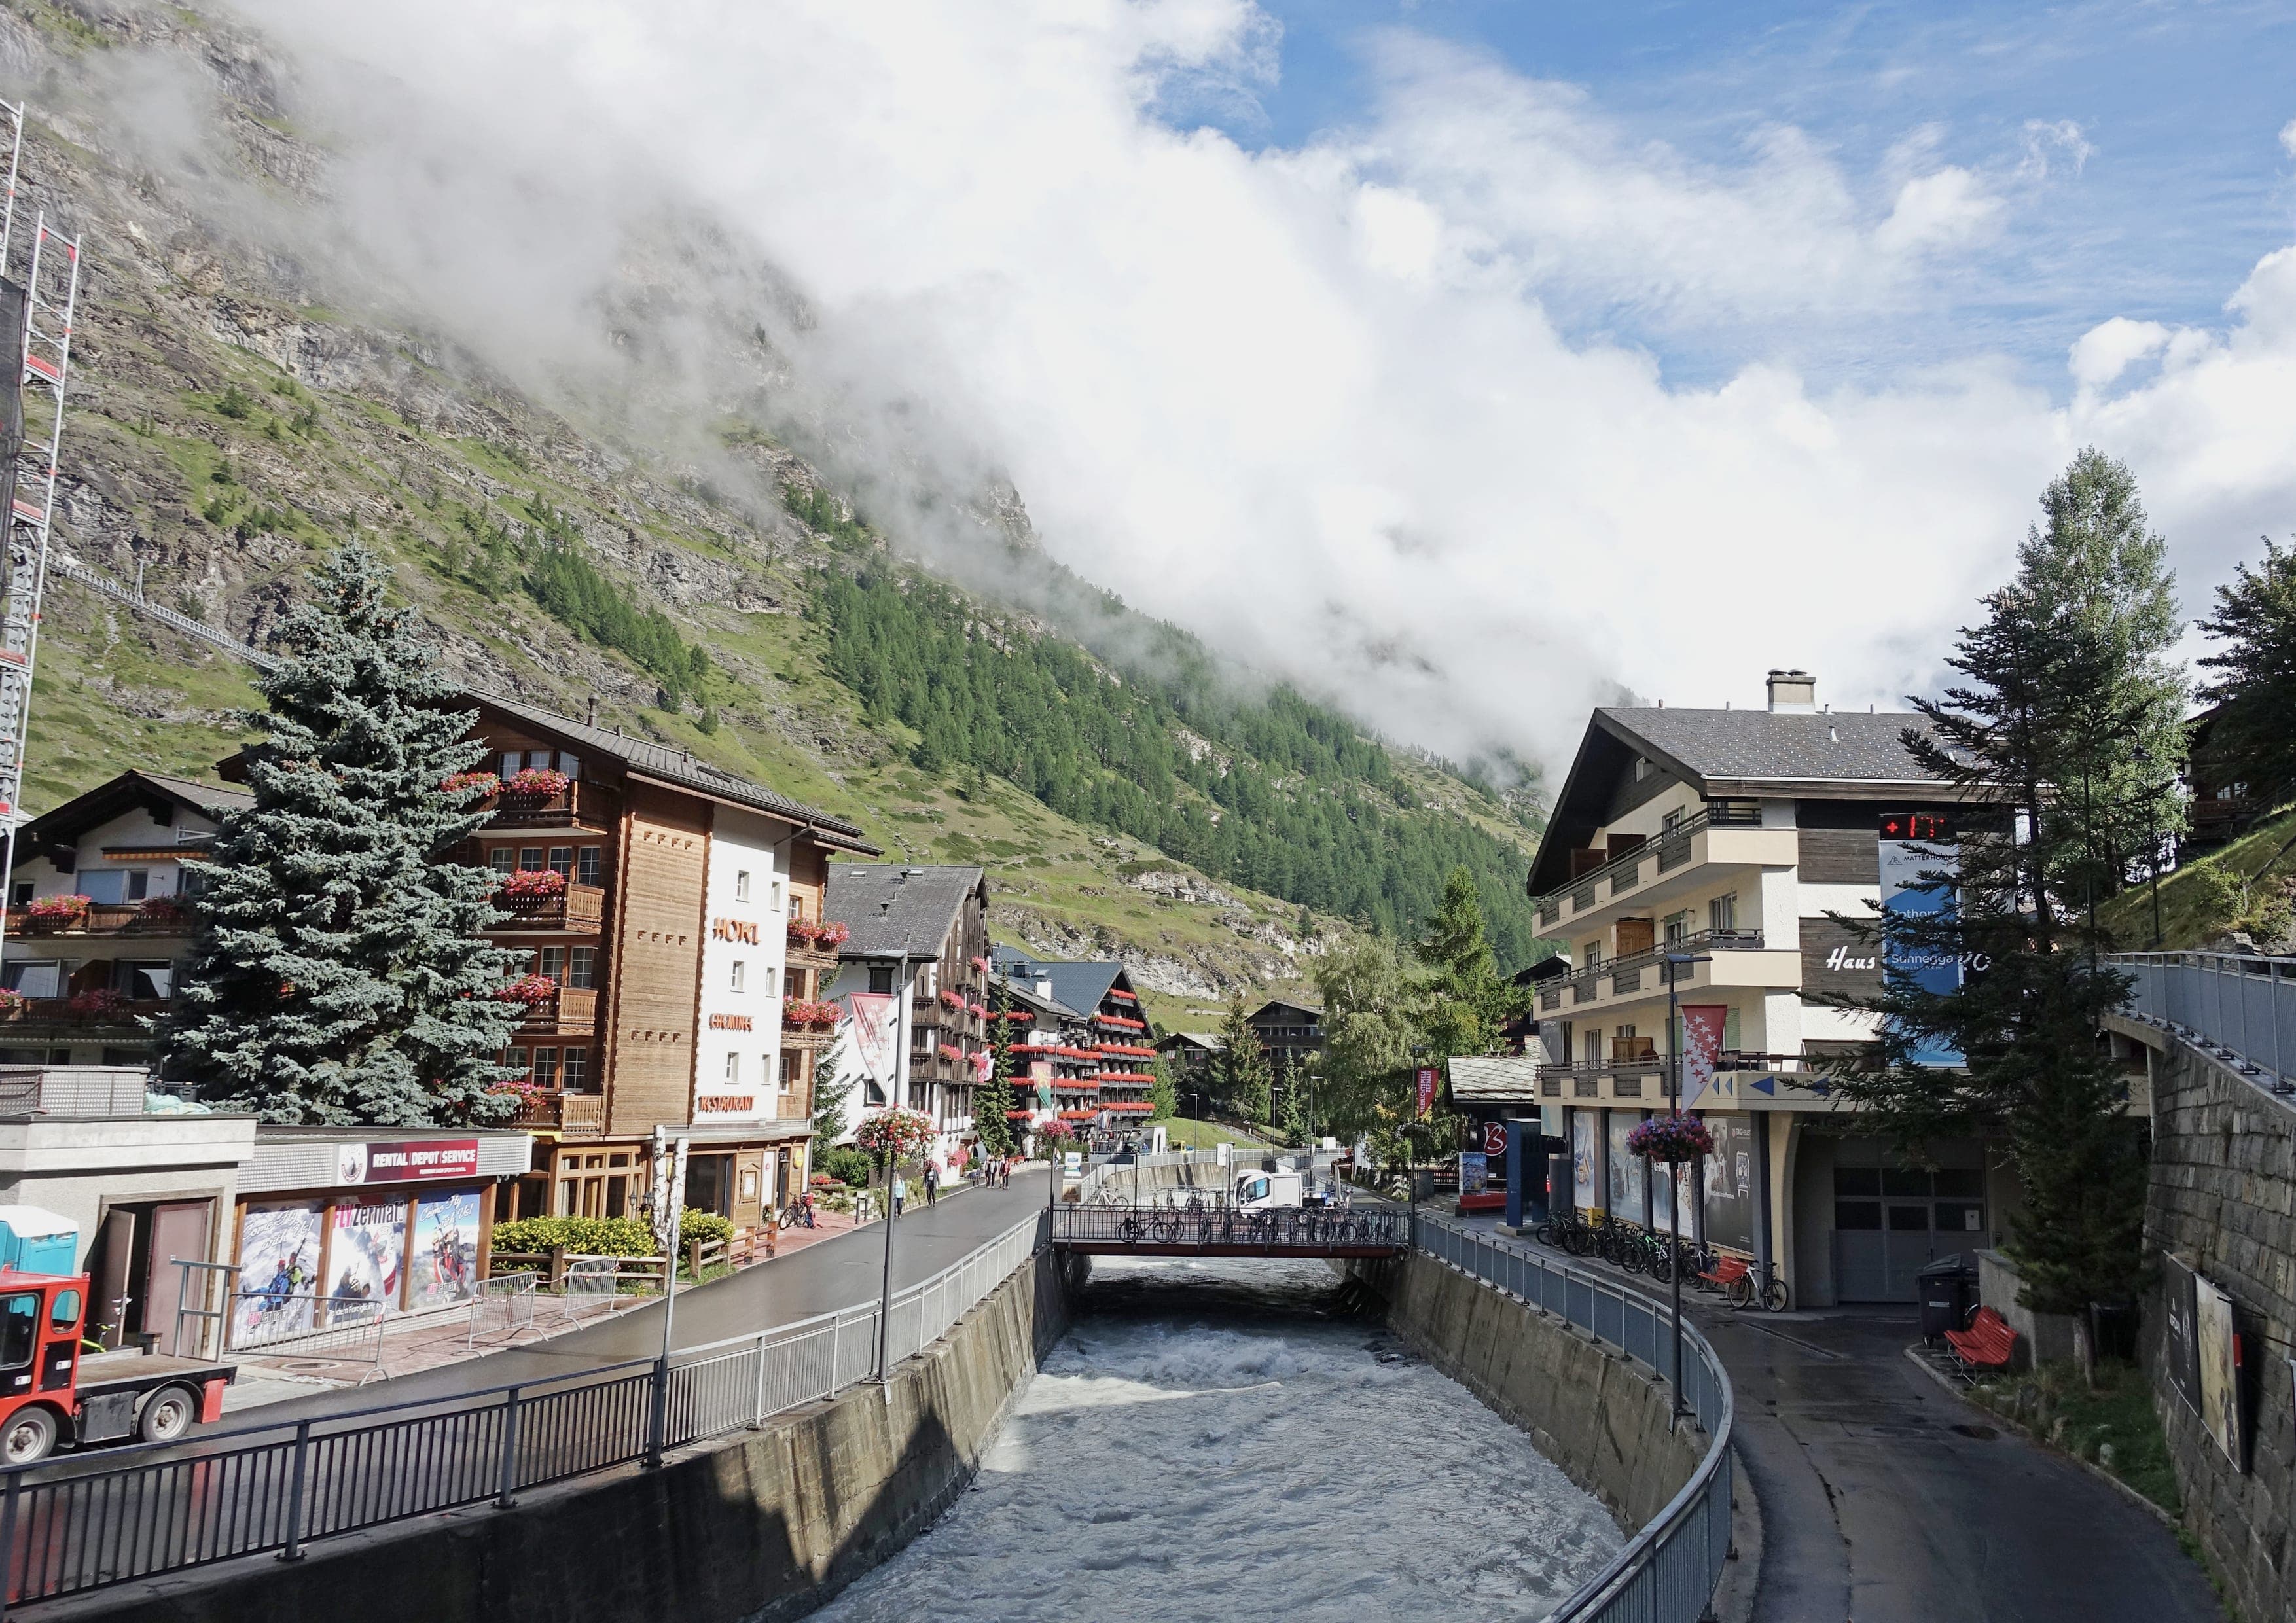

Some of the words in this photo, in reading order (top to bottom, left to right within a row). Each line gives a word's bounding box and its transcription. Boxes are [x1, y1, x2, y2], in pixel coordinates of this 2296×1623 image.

[713, 917, 761, 944] HOTEL
[1826, 946, 1875, 971] Haus
[1891, 954, 1954, 965] Sunnegga
[699, 1095, 755, 1113] RESTAURANT
[372, 1152, 409, 1168] RENTAL
[411, 1151, 440, 1166] DEPOT
[441, 1149, 476, 1164] SERVICE
[420, 1204, 444, 1222] Come
[445, 1194, 463, 1209] Fly
[436, 1213, 456, 1230] with
[457, 1203, 475, 1220] Us!
[243, 1219, 274, 1240] Come
[275, 1209, 300, 1226] Fly
[262, 1228, 287, 1251] with
